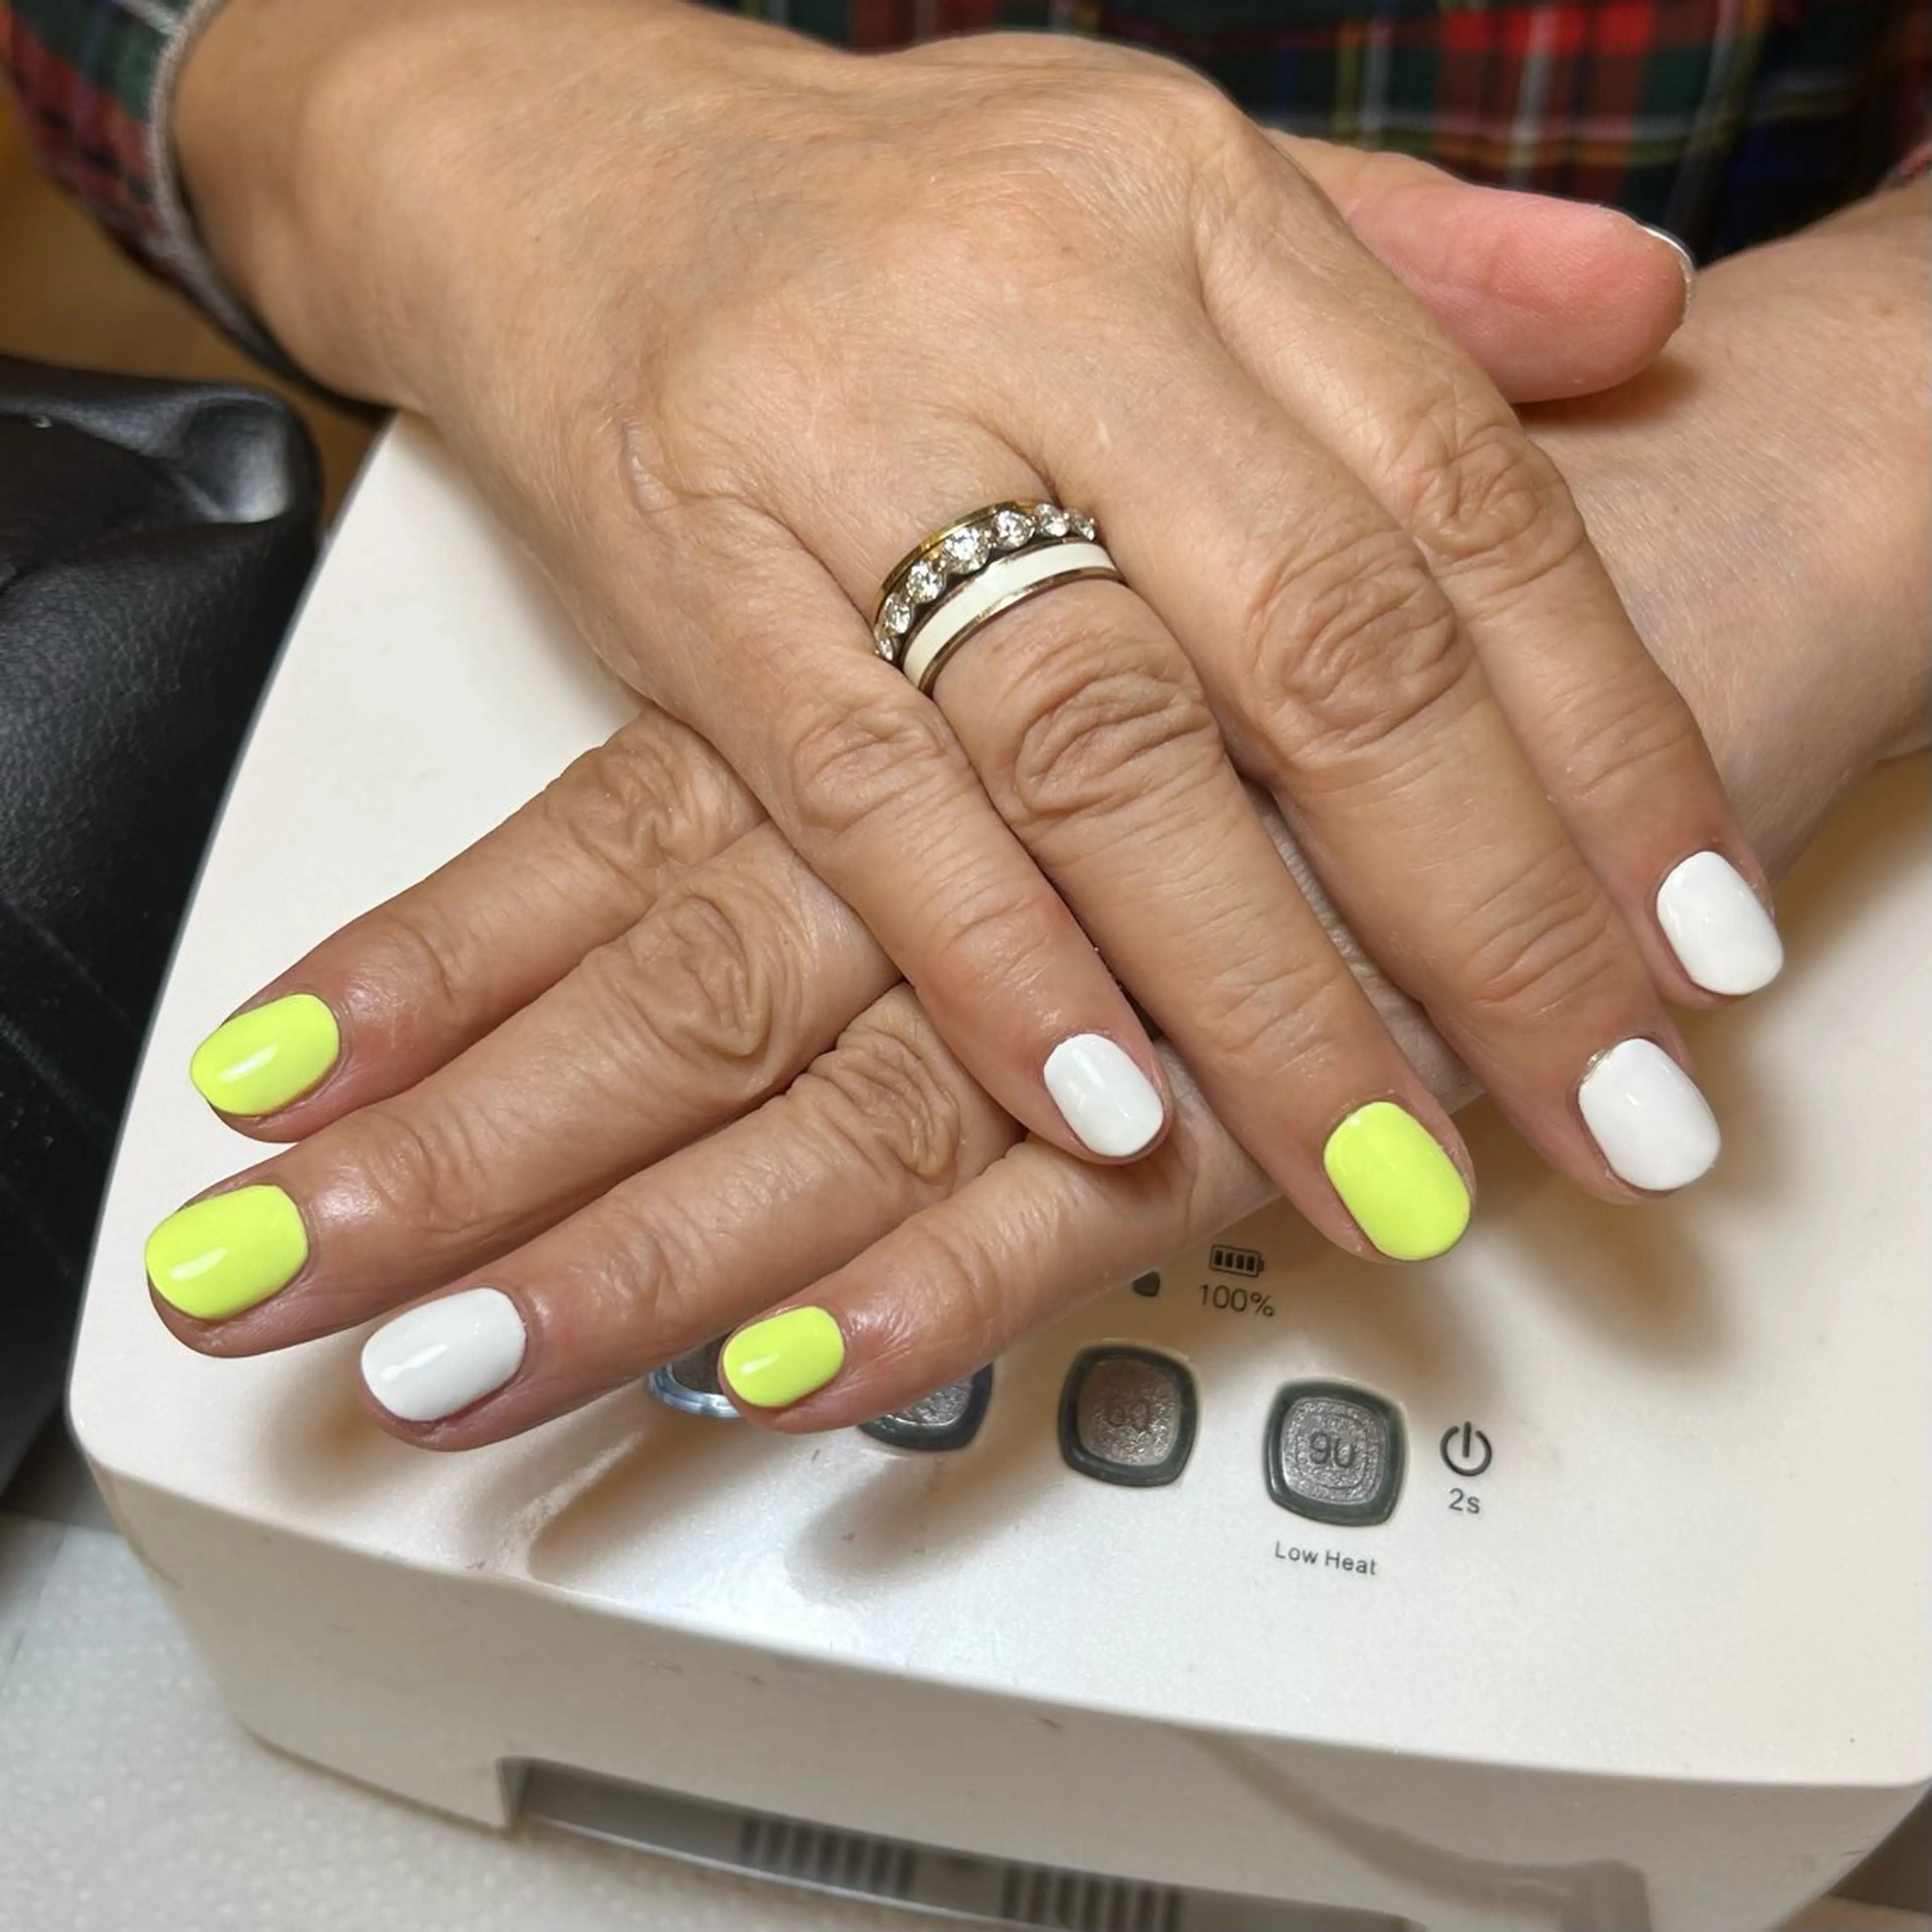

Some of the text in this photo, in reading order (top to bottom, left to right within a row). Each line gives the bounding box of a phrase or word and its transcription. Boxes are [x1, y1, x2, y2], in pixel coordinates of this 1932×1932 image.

[1198, 1284, 1274, 1318] 100%
[1448, 1487, 1481, 1514] 2s
[1275, 1540, 1376, 1575] Low Heat
